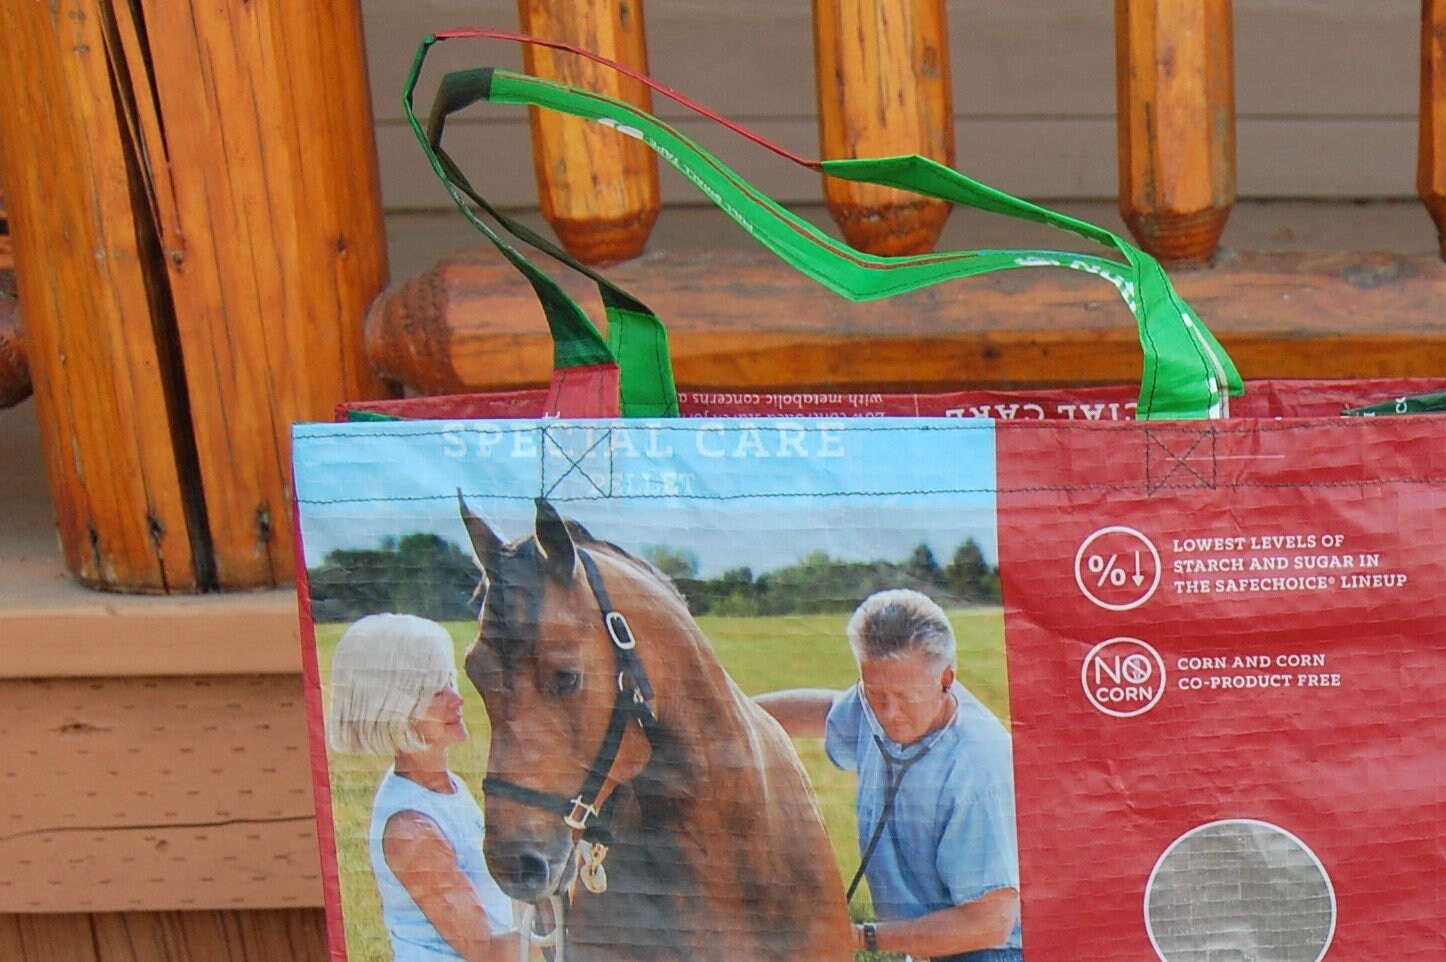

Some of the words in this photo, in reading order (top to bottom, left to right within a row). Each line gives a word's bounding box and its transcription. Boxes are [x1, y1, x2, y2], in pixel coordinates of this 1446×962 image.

[692, 393, 760, 404] concerns
[766, 394, 842, 409] metabolic
[849, 393, 884, 407] with
[442, 420, 673, 458] SPECIAL
[695, 420, 847, 458] CARE
[590, 471, 697, 495] PELLET
[1173, 537, 1246, 553] LOWEST
[1250, 535, 1317, 551] LEVELS
[1321, 534, 1345, 548] OF
[1173, 558, 1245, 573] STARCH
[1249, 556, 1290, 571] AND
[1293, 555, 1355, 570] SUGAR
[1359, 554, 1380, 567] IN
[1174, 579, 1211, 595] THE
[1341, 574, 1408, 589] LINEUP
[1095, 654, 1153, 684] NO
[1177, 656, 1227, 671] CORN
[1232, 655, 1272, 669] AND
[1276, 653, 1326, 668] CORN
[1178, 674, 1293, 690] CO-PRODUCT
[1297, 674, 1341, 688] FREE
[1097, 686, 1153, 703] CORN
